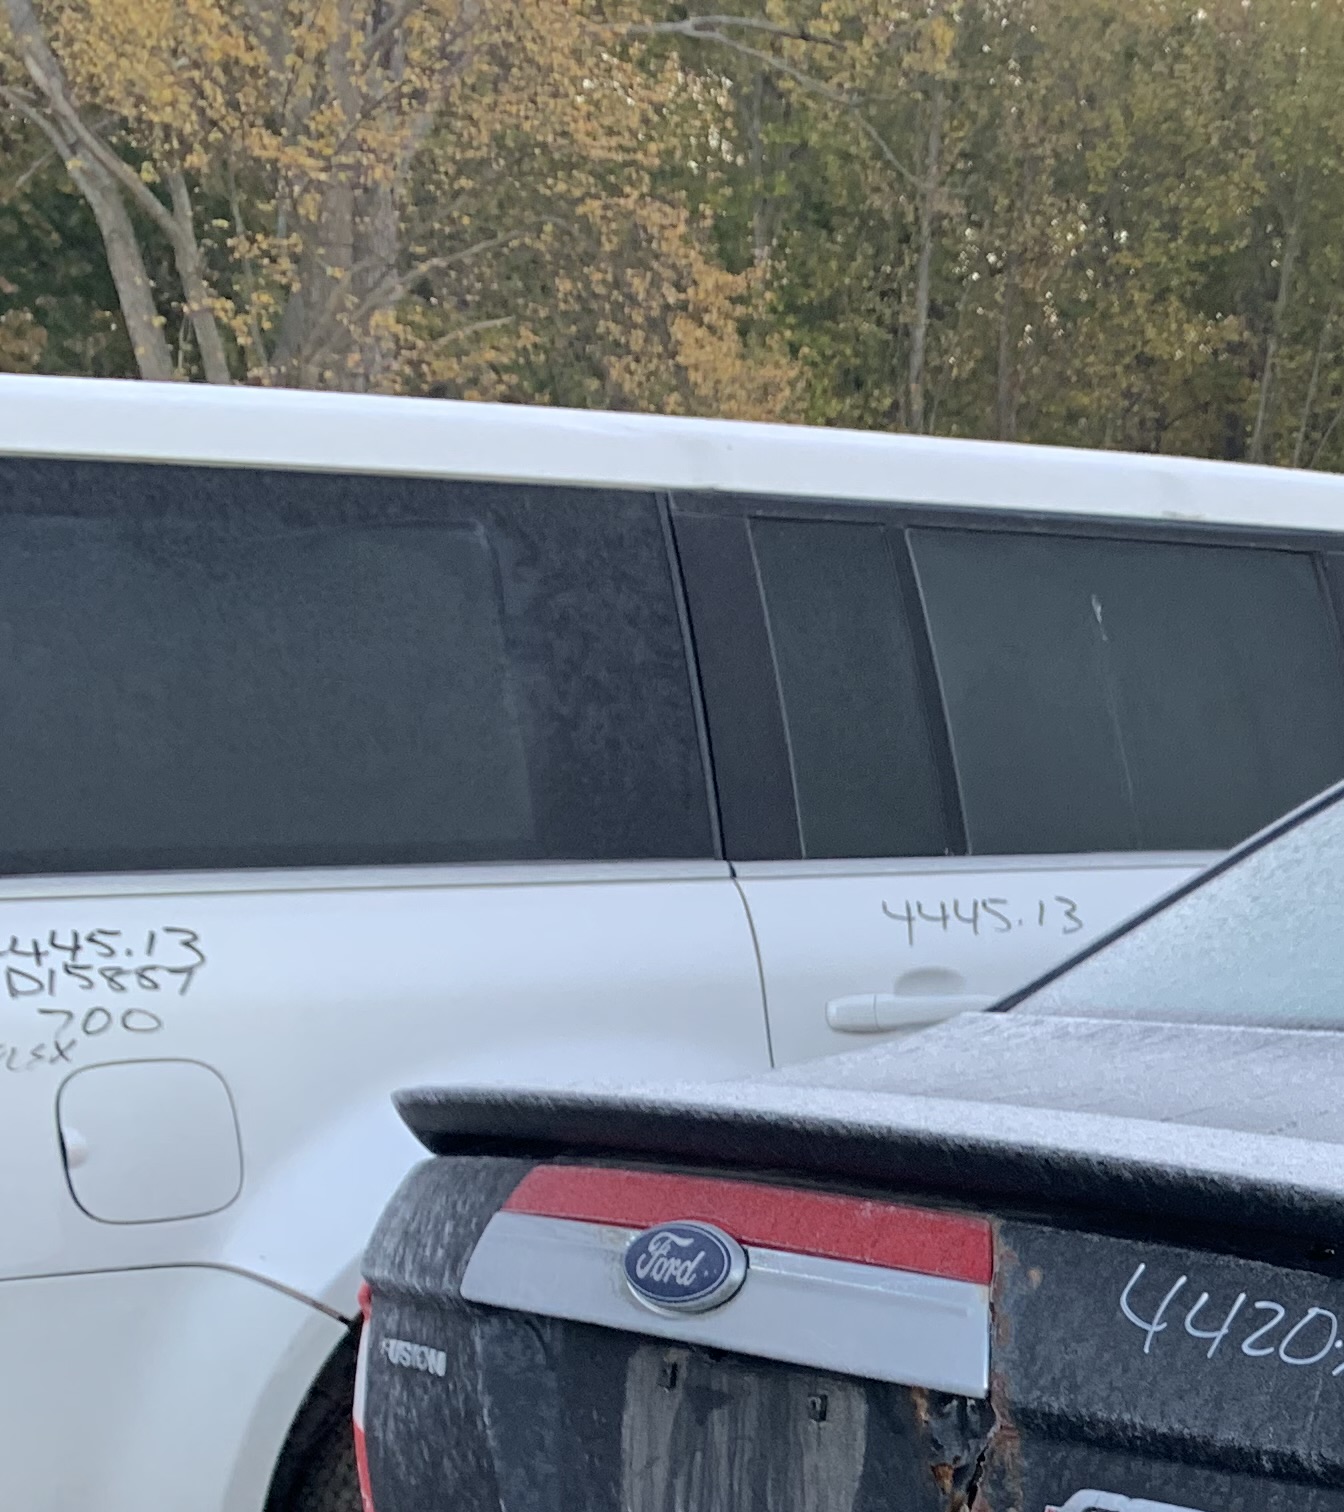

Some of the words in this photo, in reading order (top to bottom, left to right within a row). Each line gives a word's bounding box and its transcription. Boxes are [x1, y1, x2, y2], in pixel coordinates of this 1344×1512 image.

[881, 896, 1084, 946] 4445.13
[0, 926, 206, 969] 445.13
[37, 1005, 162, 1037] 700
[633, 1231, 706, 1287] Ford
